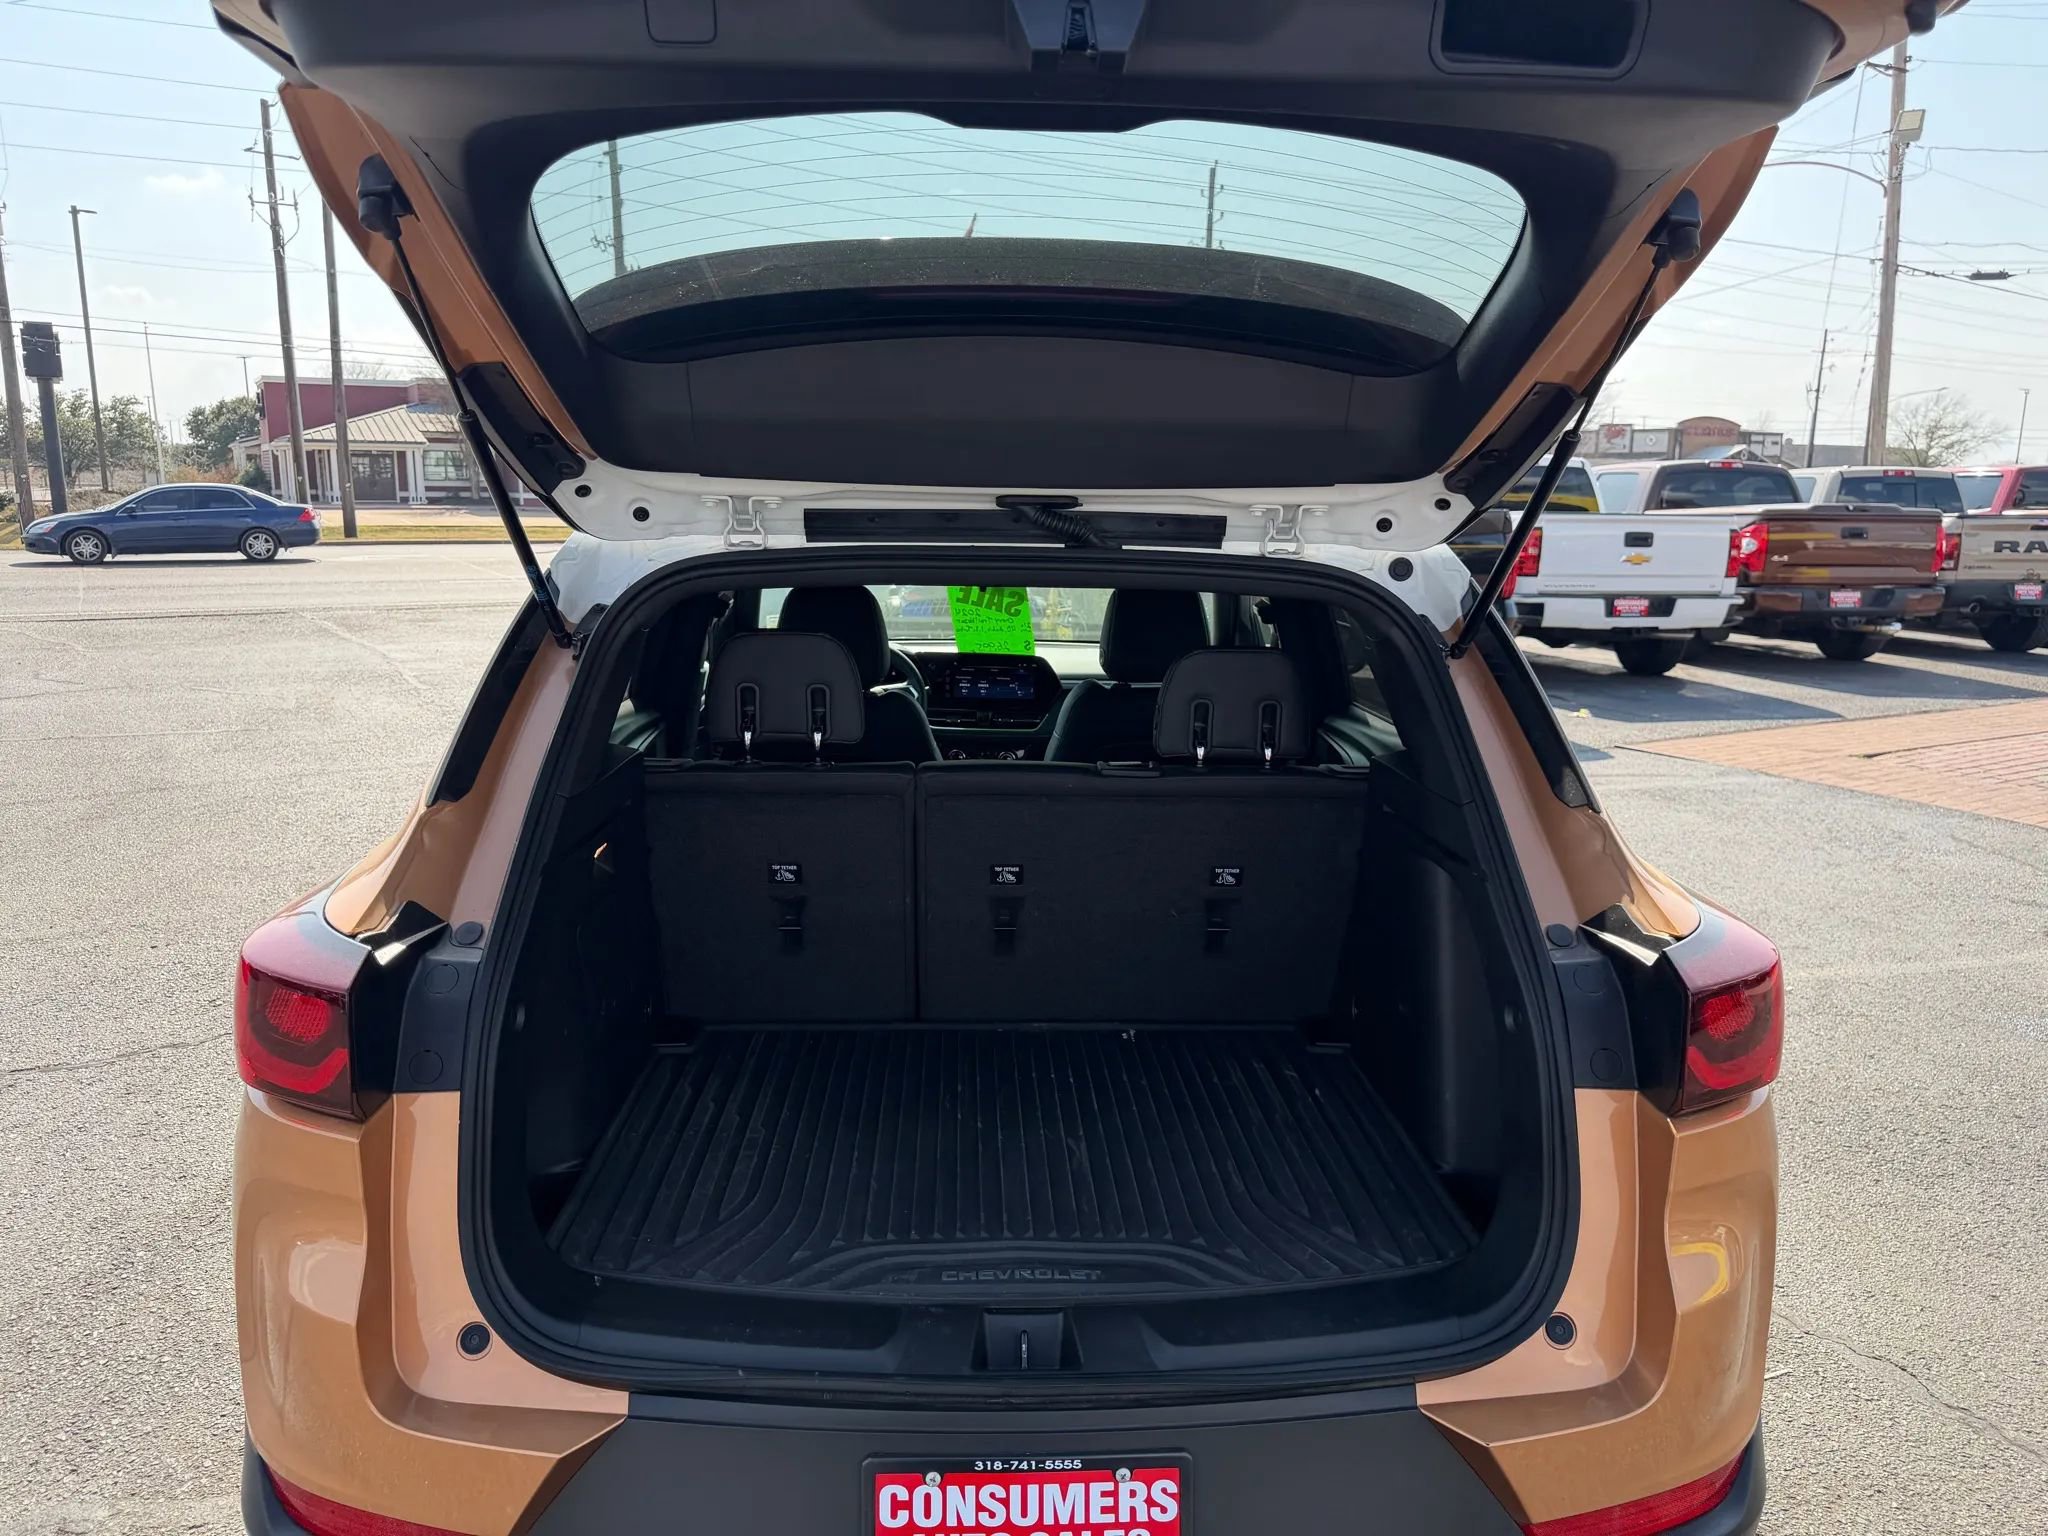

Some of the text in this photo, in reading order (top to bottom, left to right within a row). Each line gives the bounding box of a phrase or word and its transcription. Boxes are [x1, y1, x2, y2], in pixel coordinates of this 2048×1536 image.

[941, 1269, 1101, 1281] CHEVROLET
[974, 1460, 1082, 1471] 318-741-5555
[878, 1479, 1178, 1528] CONSUMERS
